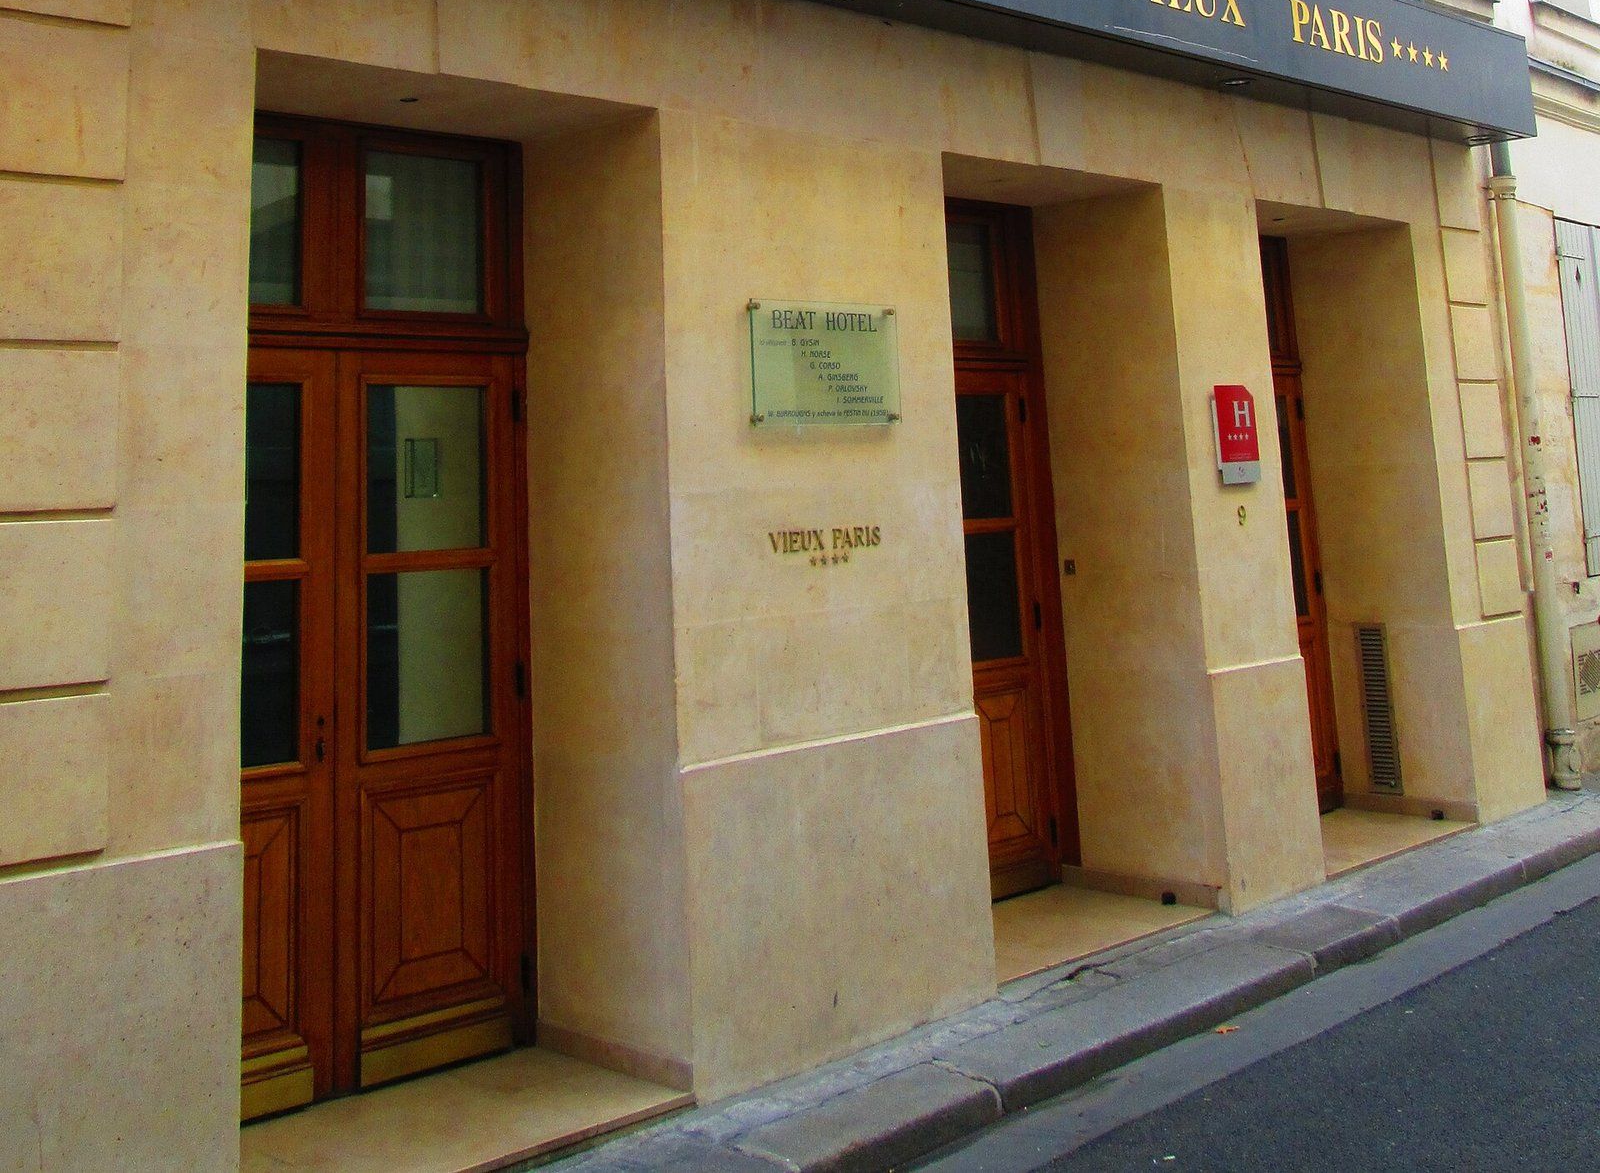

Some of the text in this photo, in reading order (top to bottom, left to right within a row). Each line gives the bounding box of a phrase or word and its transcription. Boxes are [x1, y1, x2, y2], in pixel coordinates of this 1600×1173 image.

[772, 309, 877, 332] BEAT HOTEL
[819, 362, 841, 370] CORSO
[1233, 400, 1251, 428] H
[1238, 505, 1246, 526] 9
[768, 526, 881, 554] VIEUX PARIS
